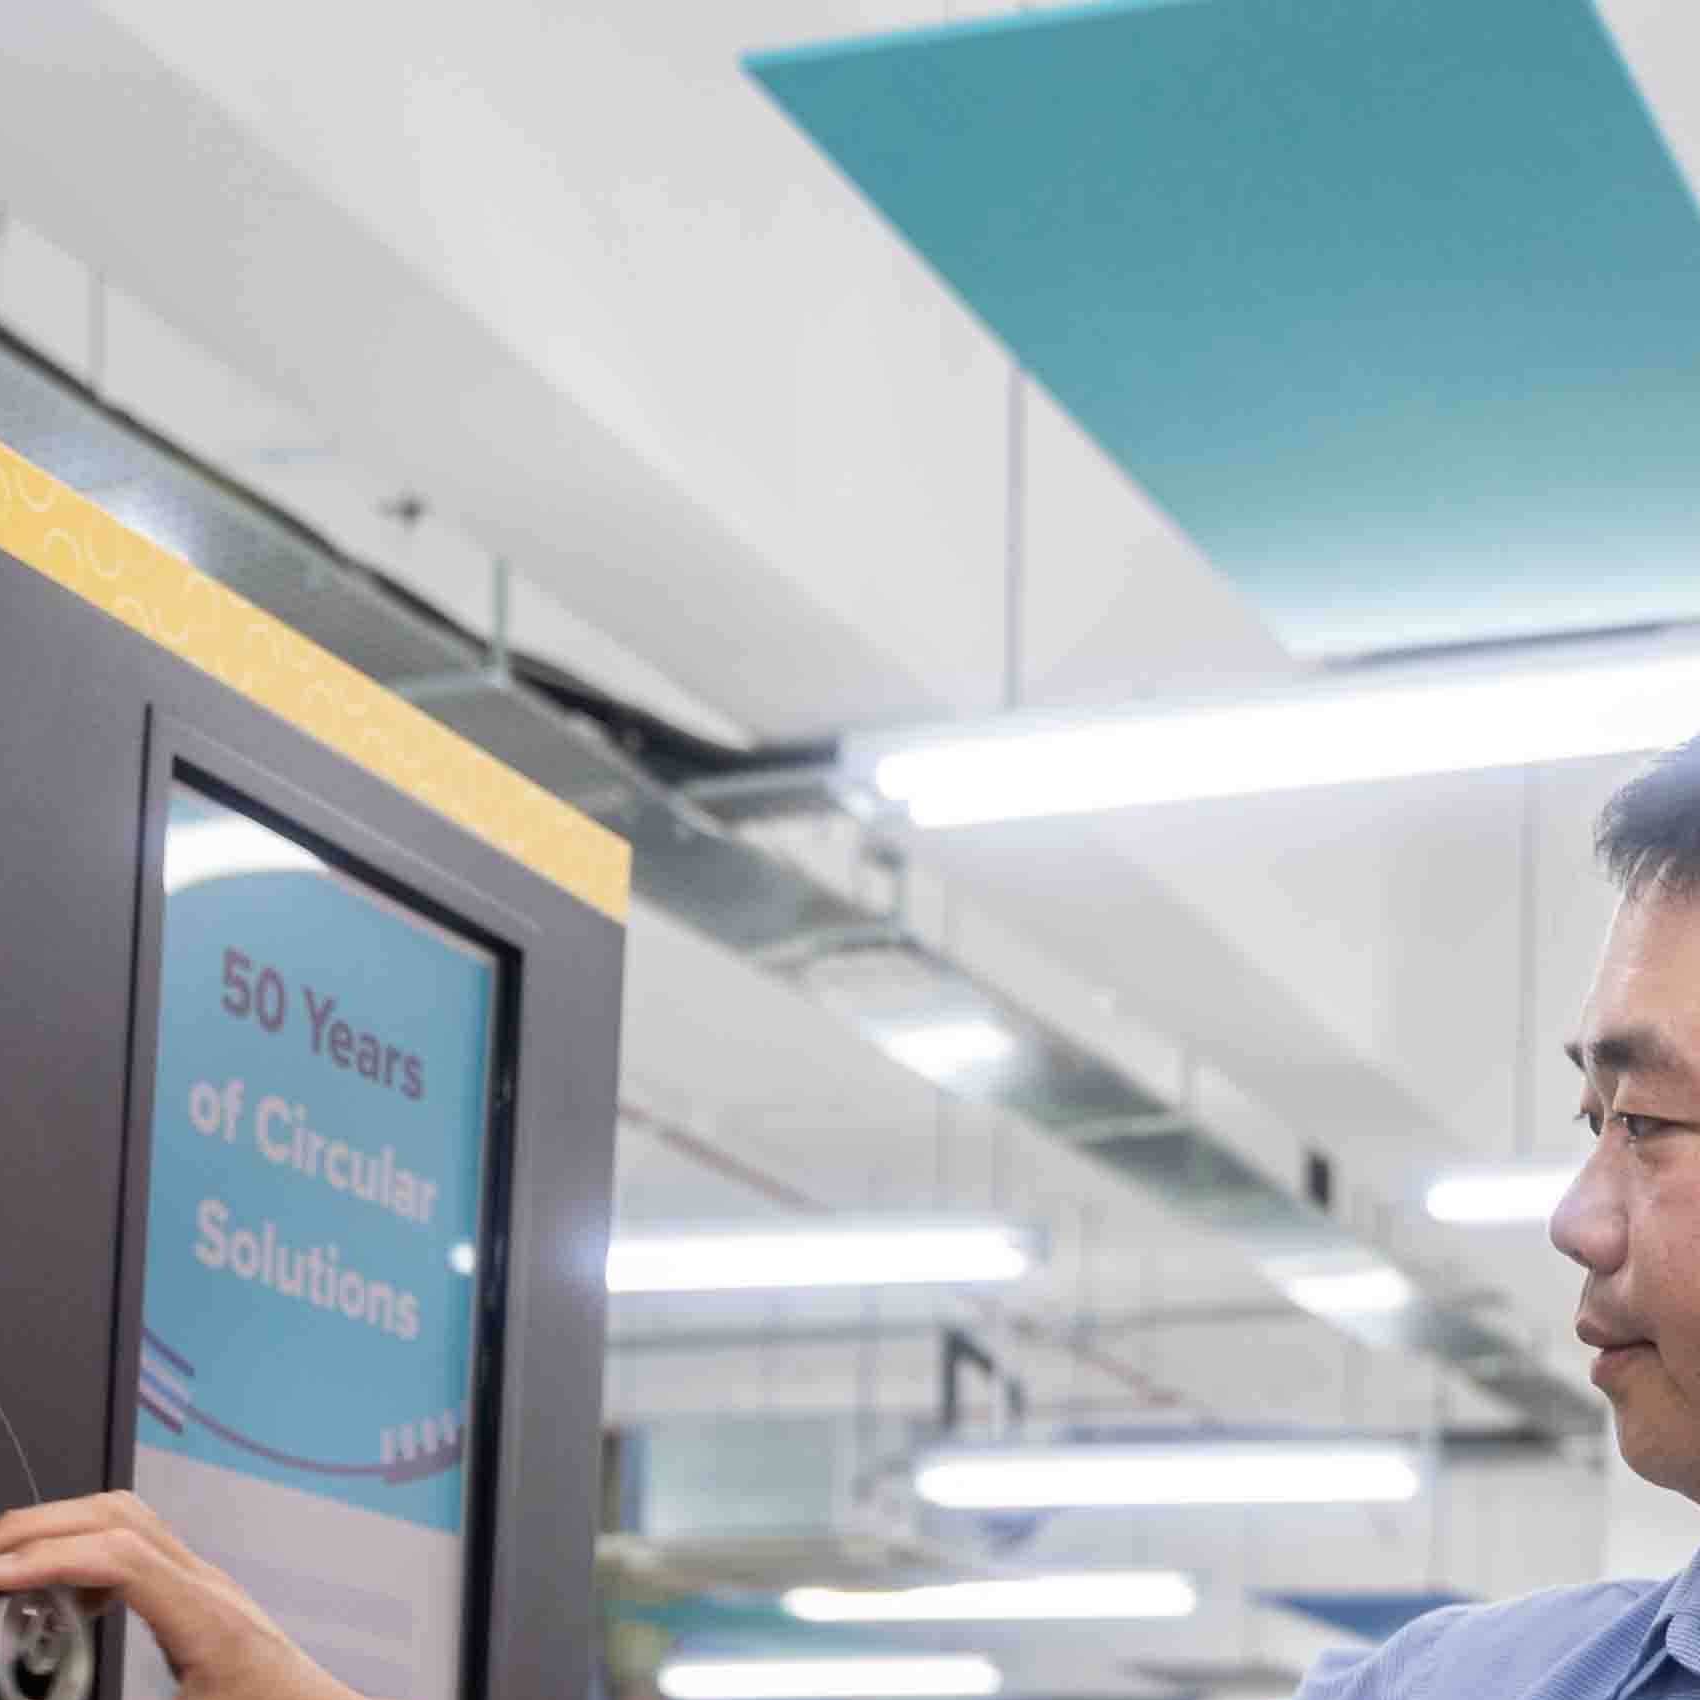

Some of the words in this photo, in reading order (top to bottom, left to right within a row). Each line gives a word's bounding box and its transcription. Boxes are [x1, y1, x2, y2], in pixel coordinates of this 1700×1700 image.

[220, 945, 286, 1034] 50
[302, 984, 425, 1101] Years
[188, 1078, 245, 1144] of
[254, 1092, 438, 1225] Circular
[193, 1197, 420, 1341] Solutions
